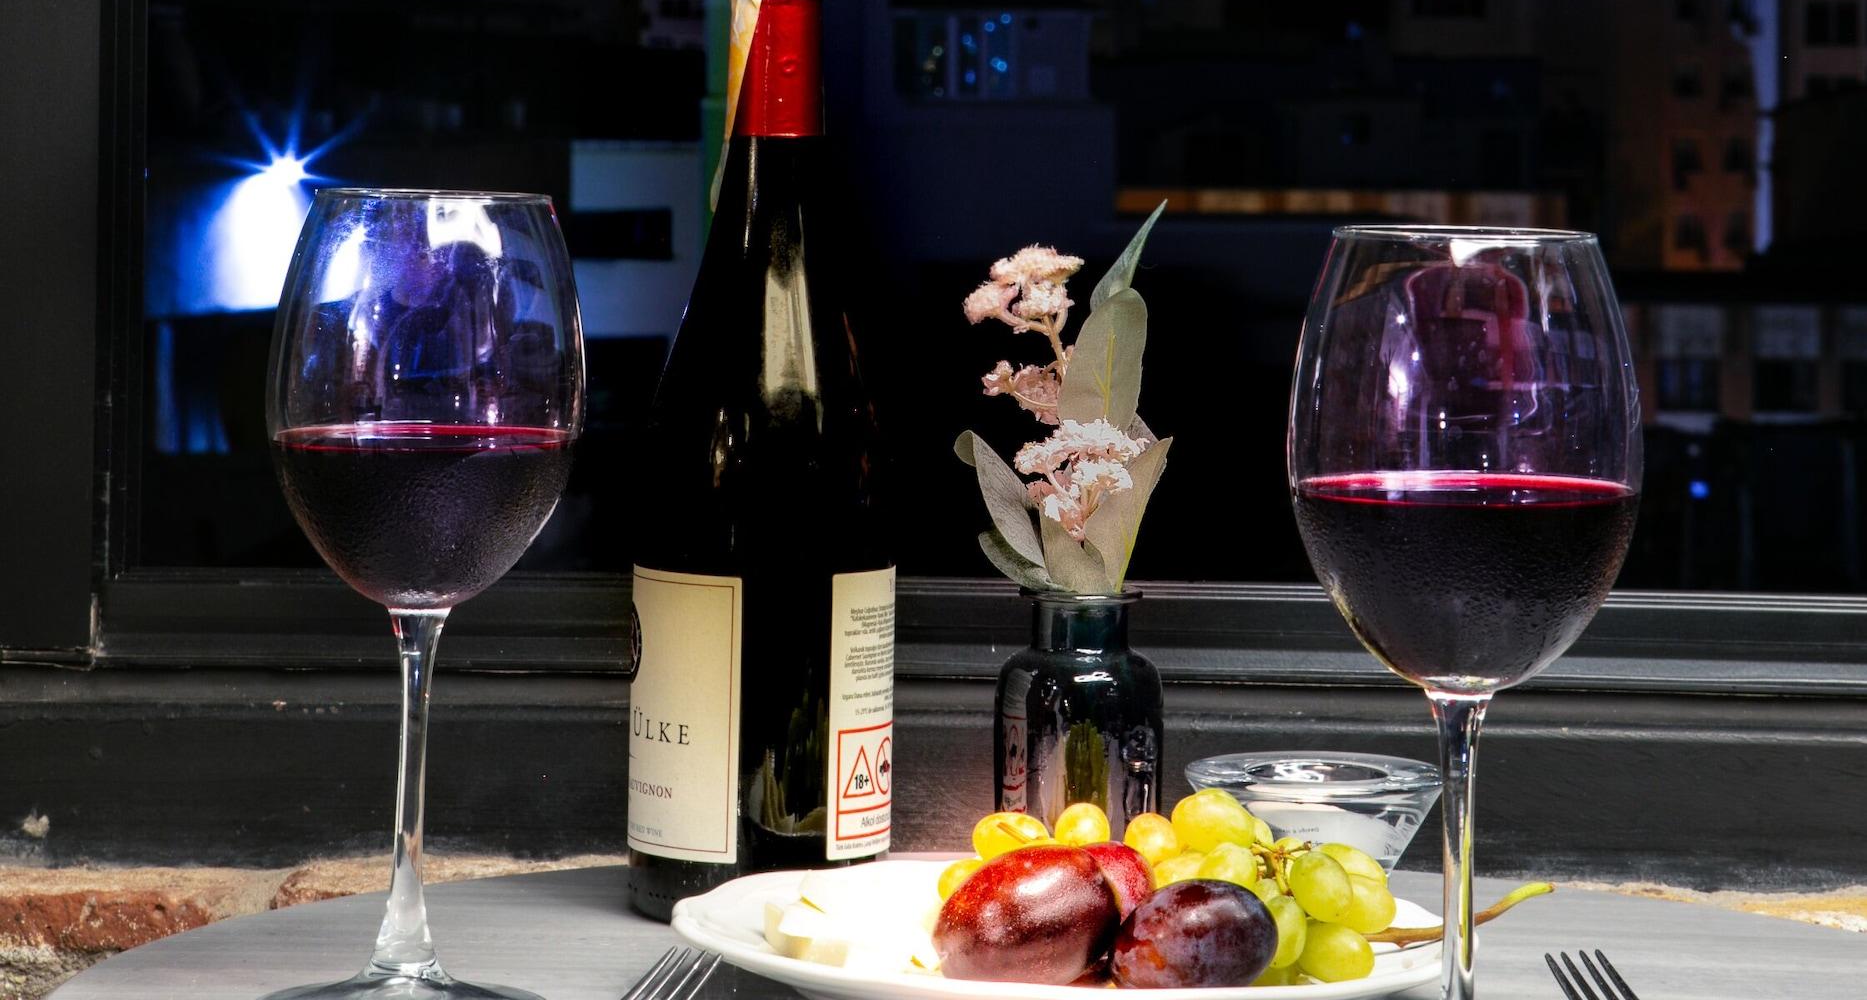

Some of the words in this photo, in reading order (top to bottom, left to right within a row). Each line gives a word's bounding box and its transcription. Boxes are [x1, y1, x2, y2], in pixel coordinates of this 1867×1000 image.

[633, 706, 690, 746] ÜLKE
[629, 778, 673, 799] UVIGNON
[854, 773, 869, 790] 18+
